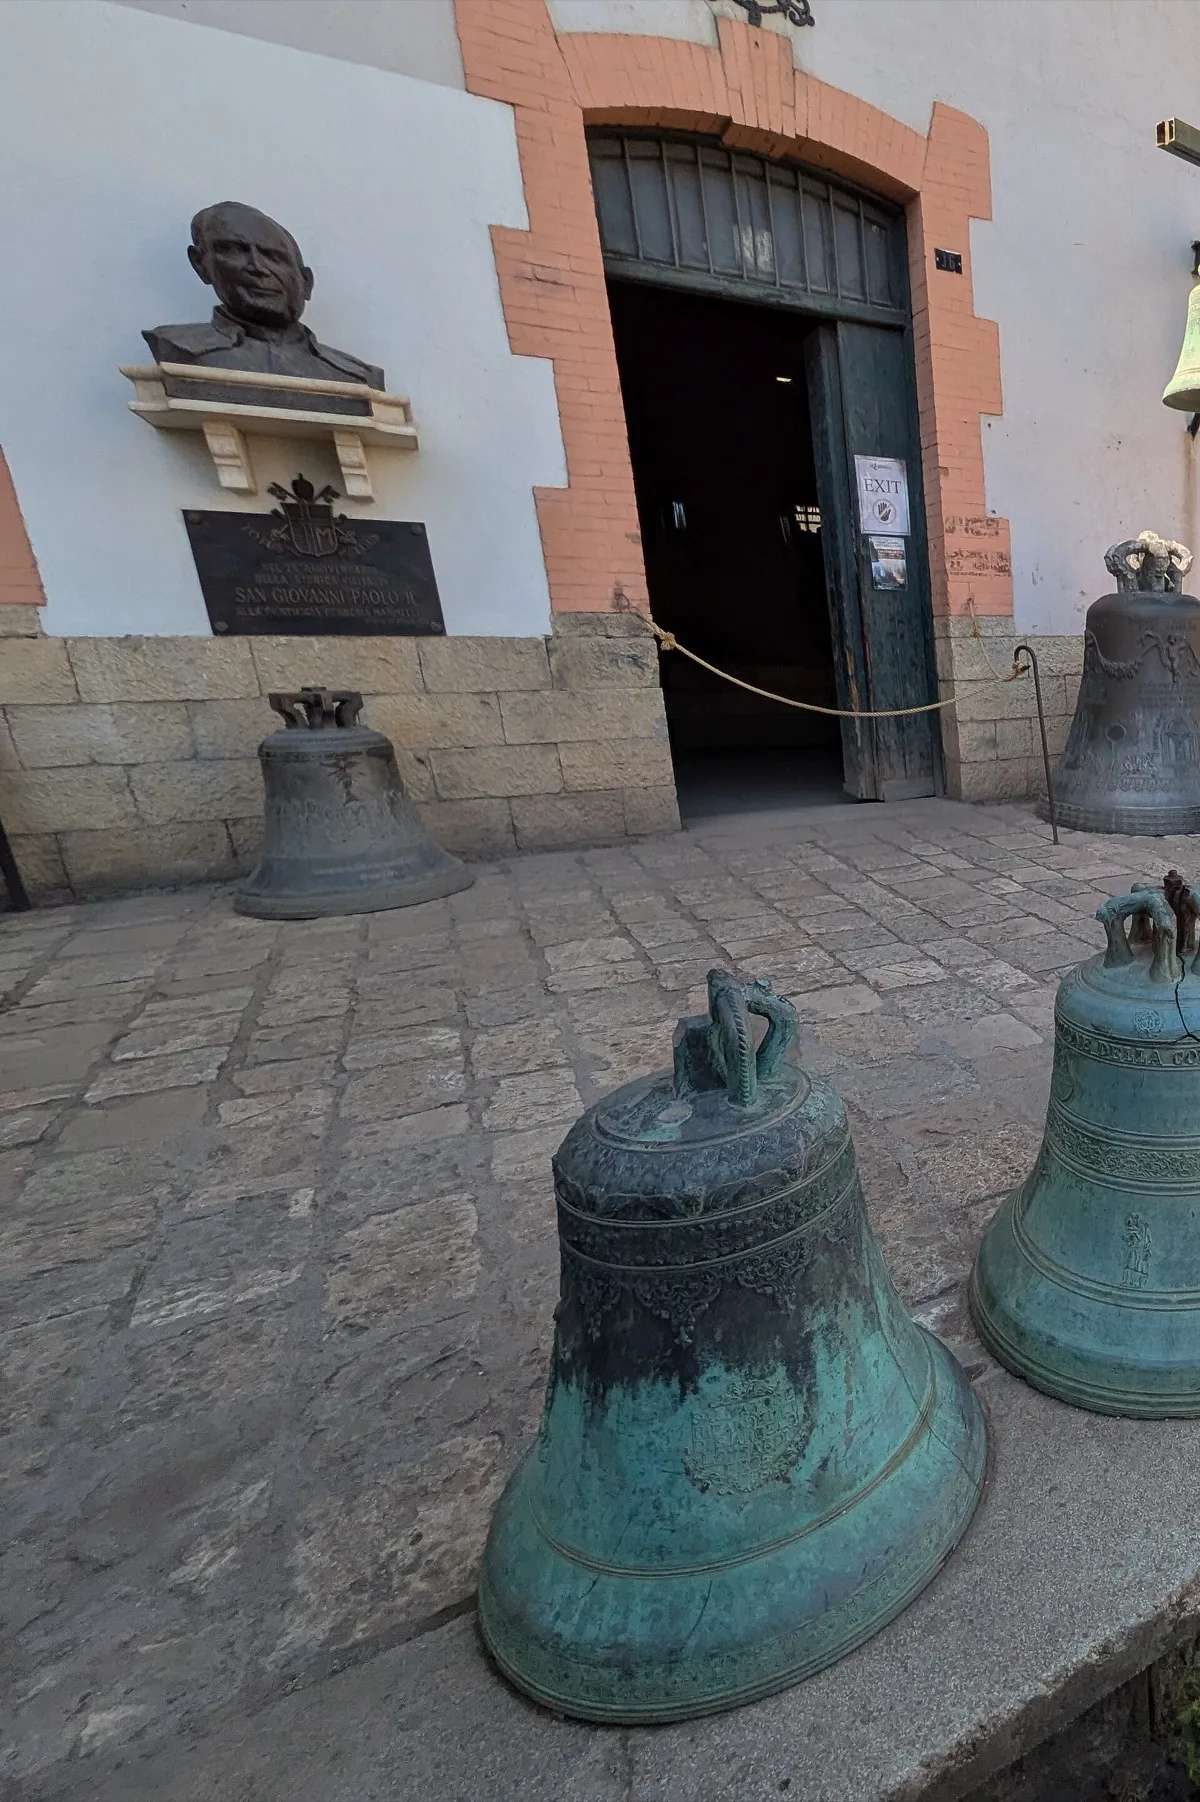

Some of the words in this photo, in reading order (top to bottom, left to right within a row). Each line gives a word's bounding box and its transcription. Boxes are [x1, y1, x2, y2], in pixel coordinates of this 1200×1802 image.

[864, 478, 901, 494] EXIT
[234, 587, 267, 604] SAN
[271, 588, 345, 606] GIOVANNI
[351, 589, 400, 606] PAOLO
[1096, 1038, 1163, 1066] DELLA
